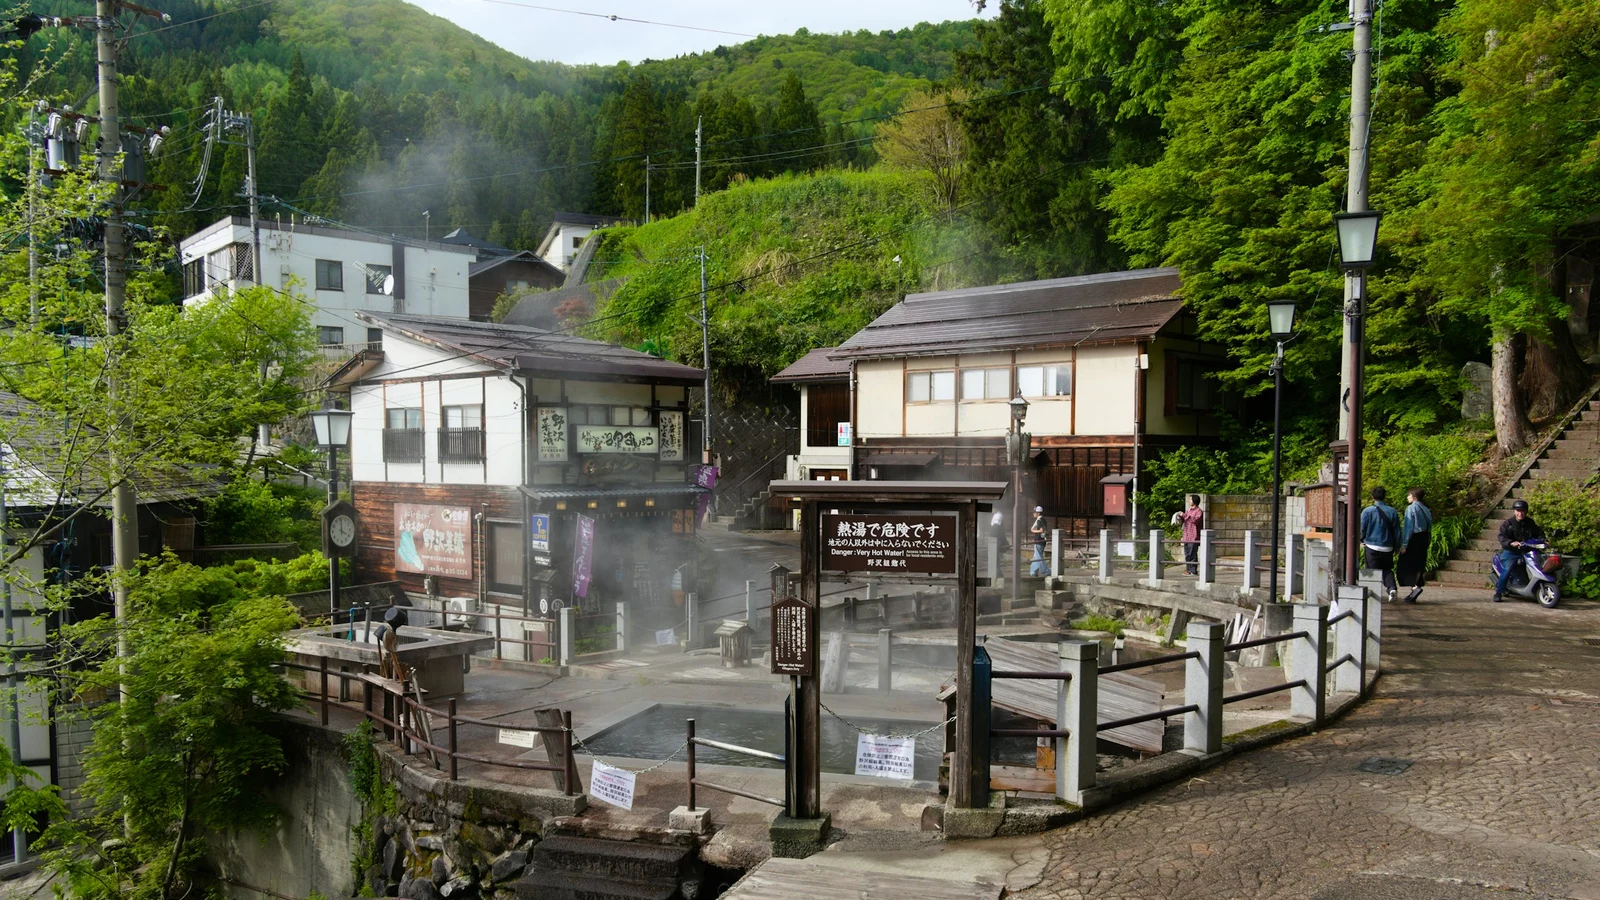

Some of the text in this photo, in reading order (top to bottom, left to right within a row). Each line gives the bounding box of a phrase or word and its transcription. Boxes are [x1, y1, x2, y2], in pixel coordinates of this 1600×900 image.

[837, 521, 940, 538] 熱湯で危険です
[827, 538, 950, 549] 地元の人以外は中に入らないでください
